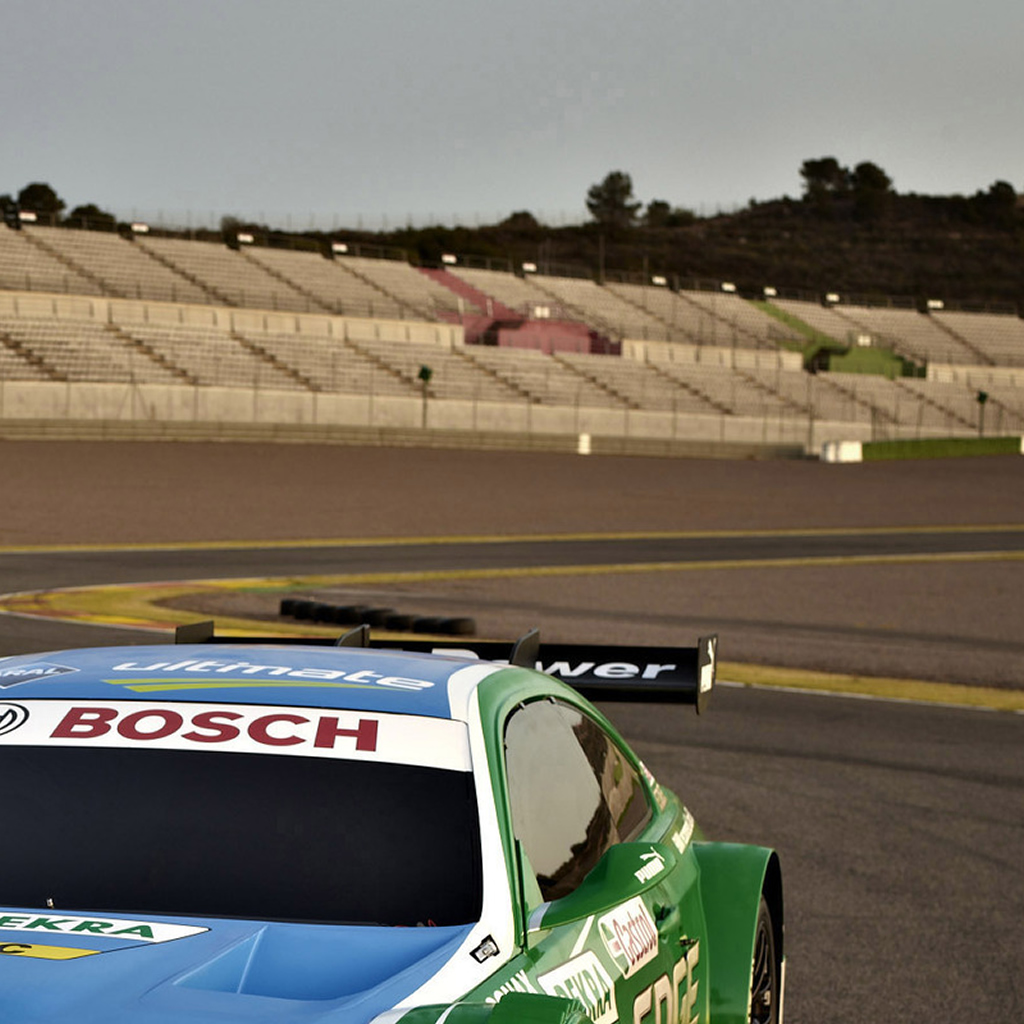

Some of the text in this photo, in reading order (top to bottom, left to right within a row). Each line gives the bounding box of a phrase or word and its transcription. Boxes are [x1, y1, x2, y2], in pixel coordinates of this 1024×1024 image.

[112, 659, 436, 691] ultimate
[49, 707, 379, 752] BOSCH
[613, 904, 657, 966] Castrol
